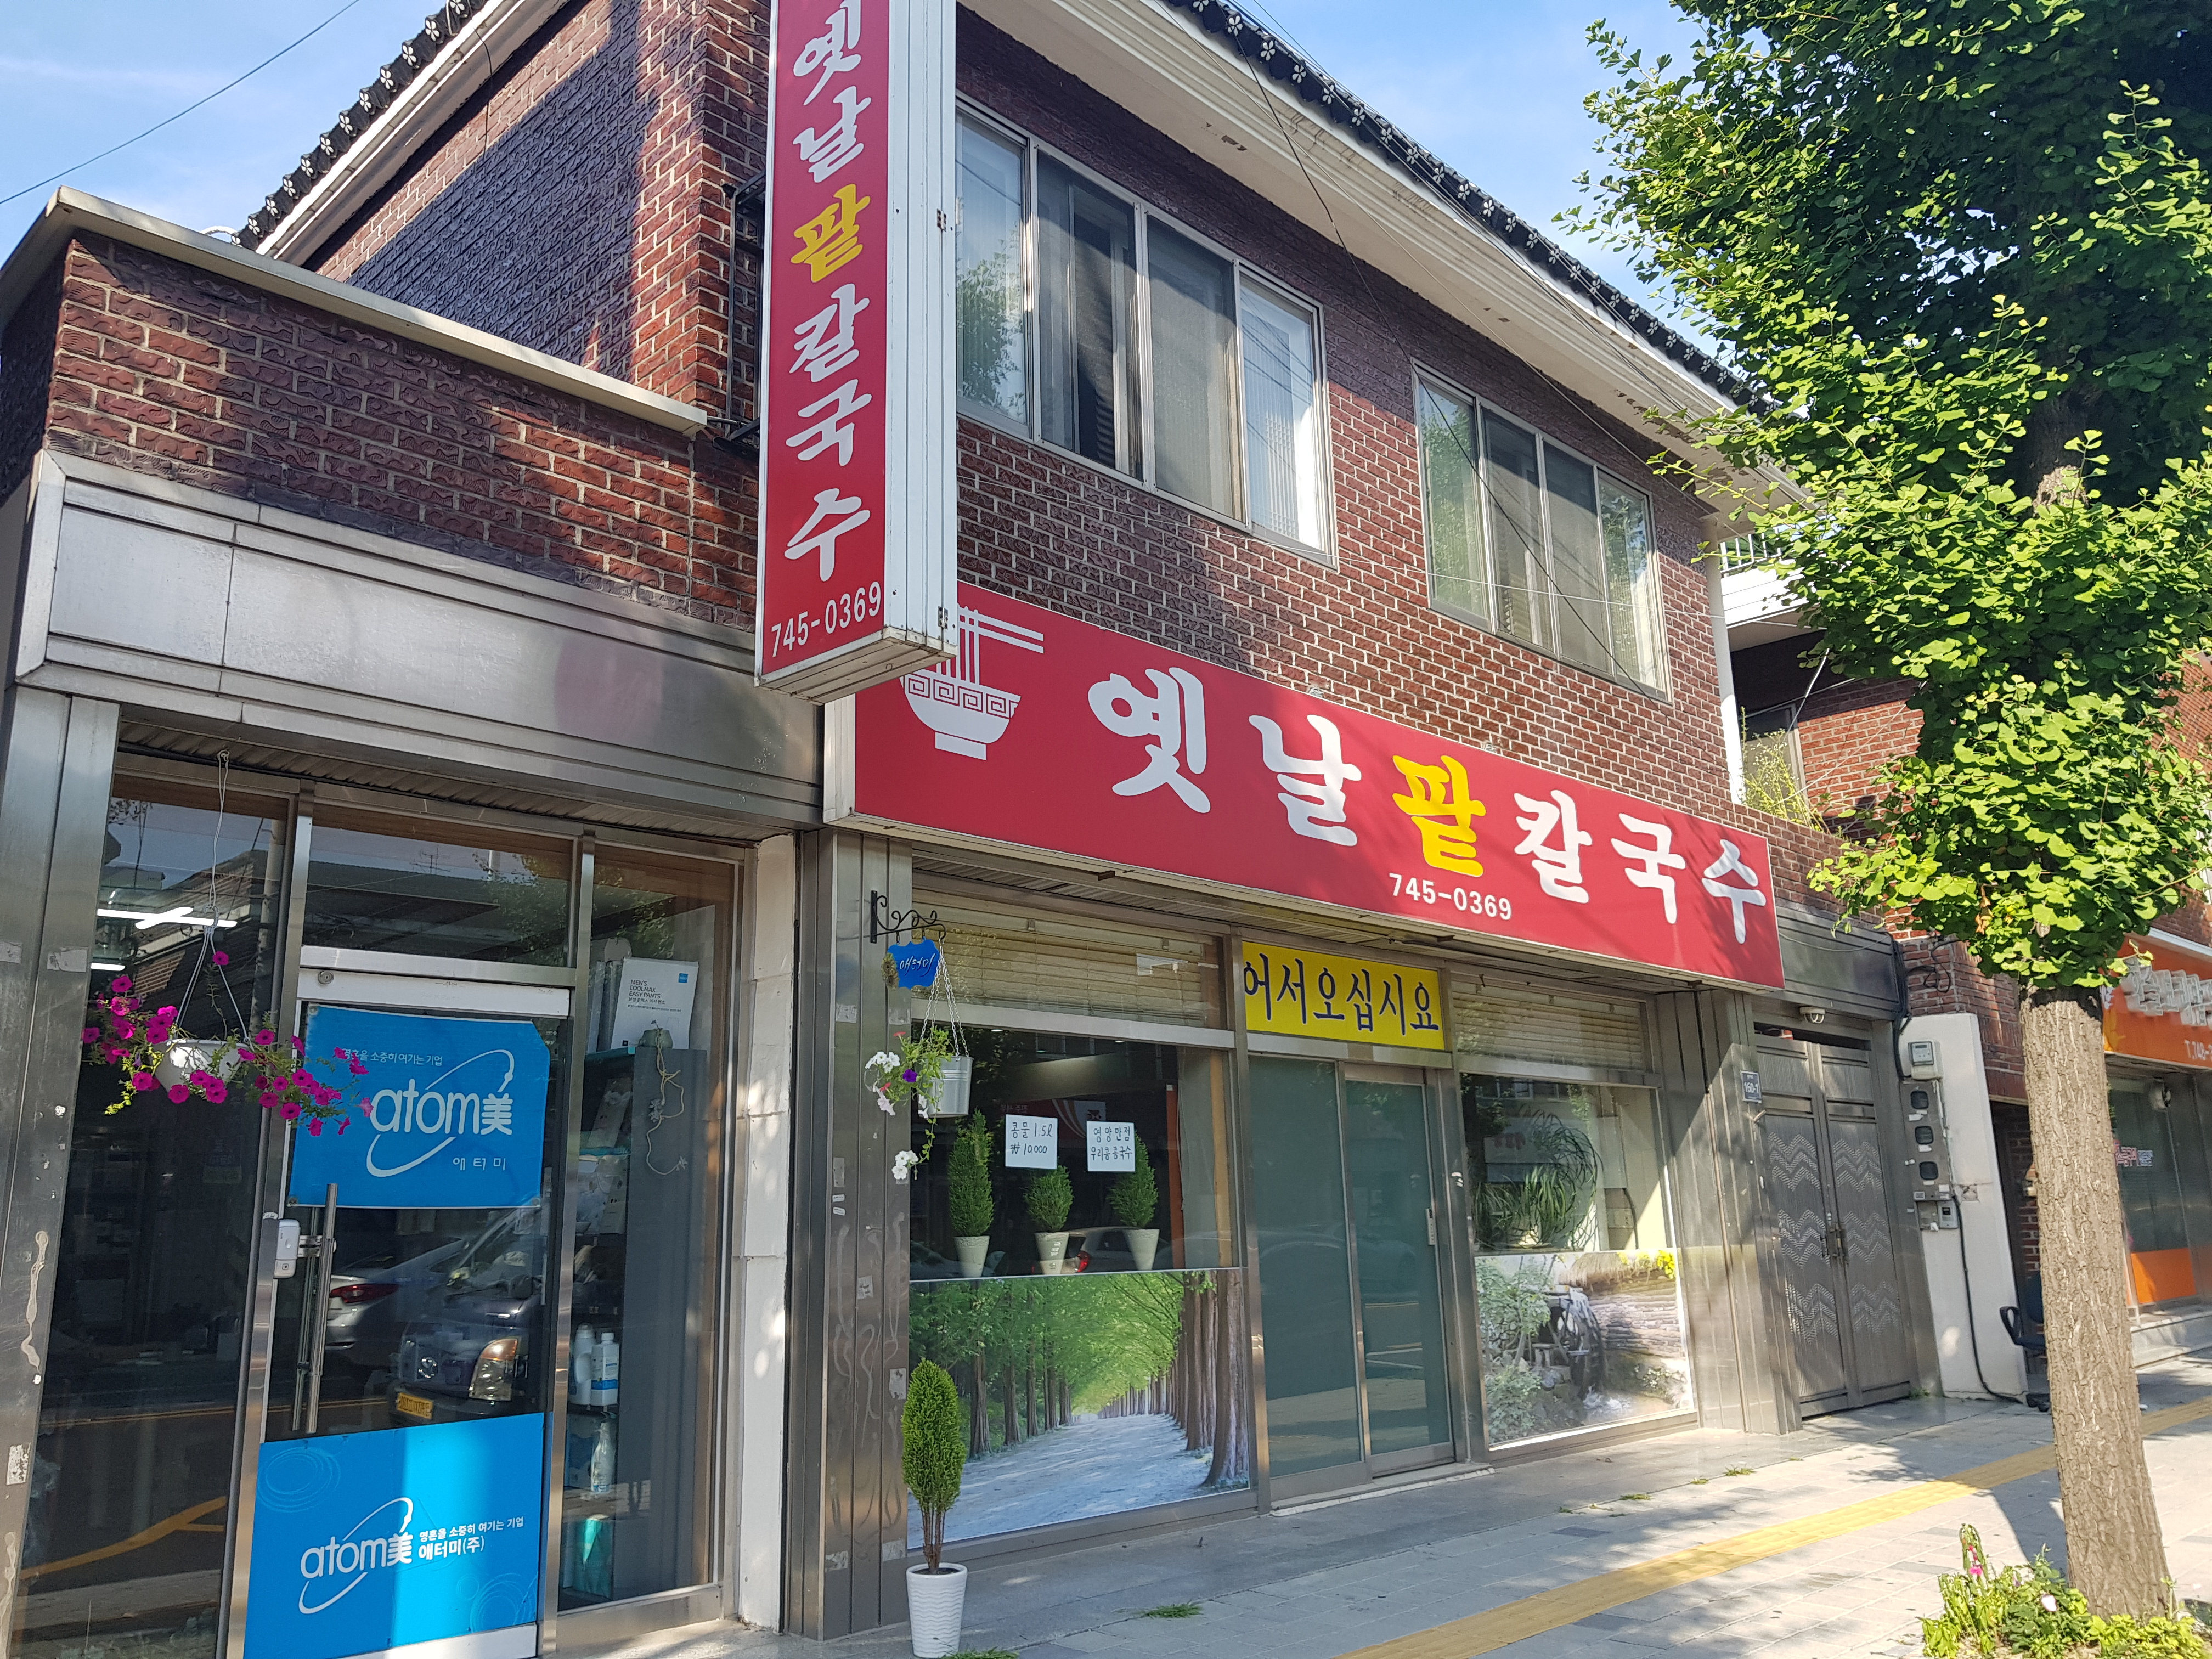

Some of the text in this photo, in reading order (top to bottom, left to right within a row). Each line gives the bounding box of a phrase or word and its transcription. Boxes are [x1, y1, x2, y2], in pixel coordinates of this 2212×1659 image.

[771, 581, 881, 658] 745-0369
[1389, 873, 1512, 921] 745-0369
[1243, 952, 1440, 1036] 어서오십시요
[370, 1052, 397, 1063] 소중히
[398, 1053, 425, 1065] 여기는
[426, 1055, 443, 1066] 기업
[1744, 1082, 1759, 1093] 160-1
[419, 1516, 524, 1542] 영혼을 소중히 여기는 기업
